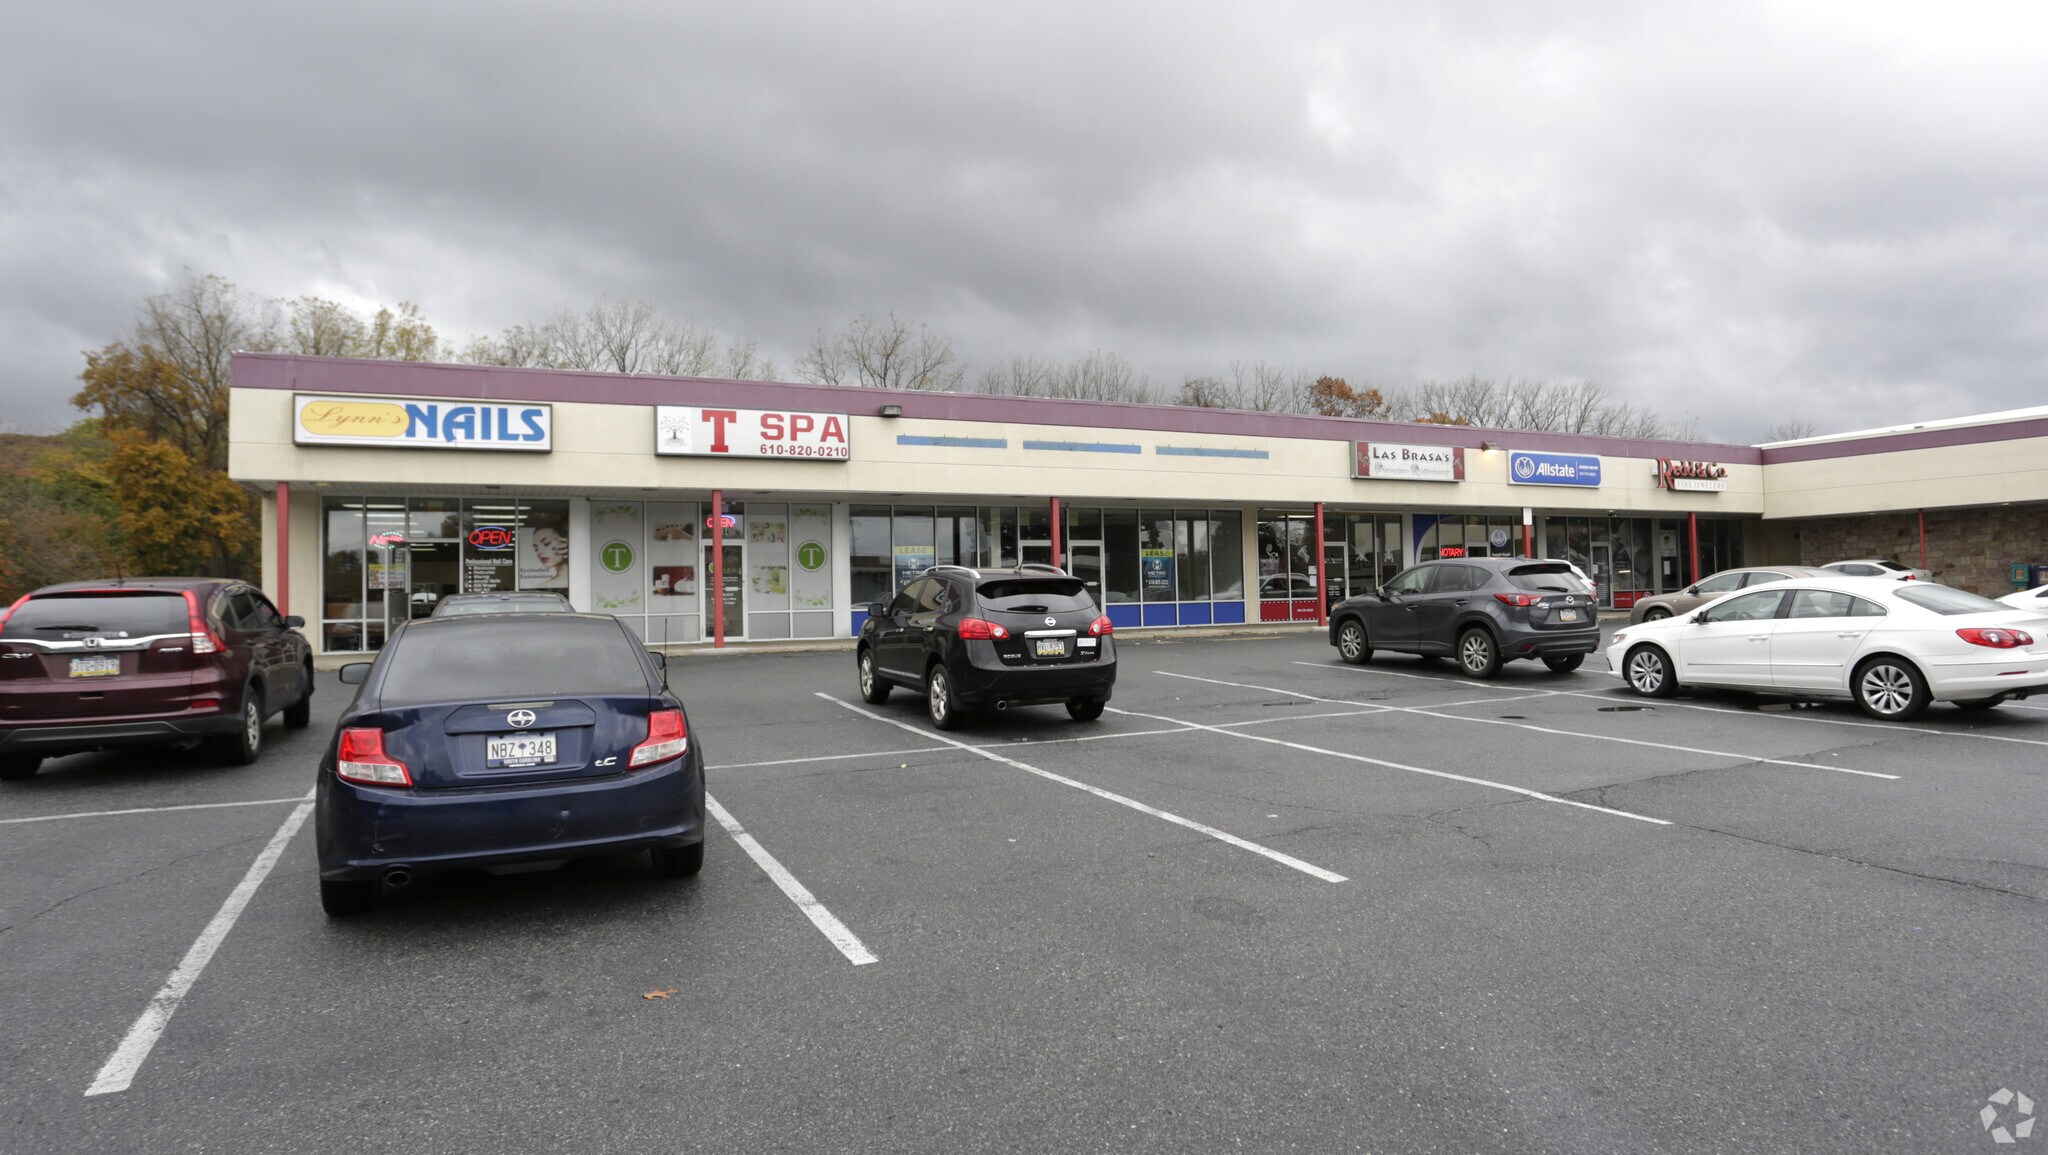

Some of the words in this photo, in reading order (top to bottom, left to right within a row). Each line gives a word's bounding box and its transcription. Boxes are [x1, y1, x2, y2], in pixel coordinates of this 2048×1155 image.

[304, 406, 402, 429] Lynn's
[405, 403, 545, 443] NAILS
[701, 409, 737, 453] T
[760, 413, 845, 443] SPA
[760, 444, 848, 457] 610-820-0210
[1536, 462, 1575, 478] Allstate
[1694, 481, 1725, 490] JEWELERS
[468, 530, 512, 545] OPEN
[803, 548, 820, 567] T
[899, 546, 928, 554] LEASE
[1440, 547, 1465, 557] NOTARY
[608, 548, 626, 568] T
[491, 742, 515, 758] NBZ
[529, 740, 551, 756] 348
[594, 756, 617, 767] tC
